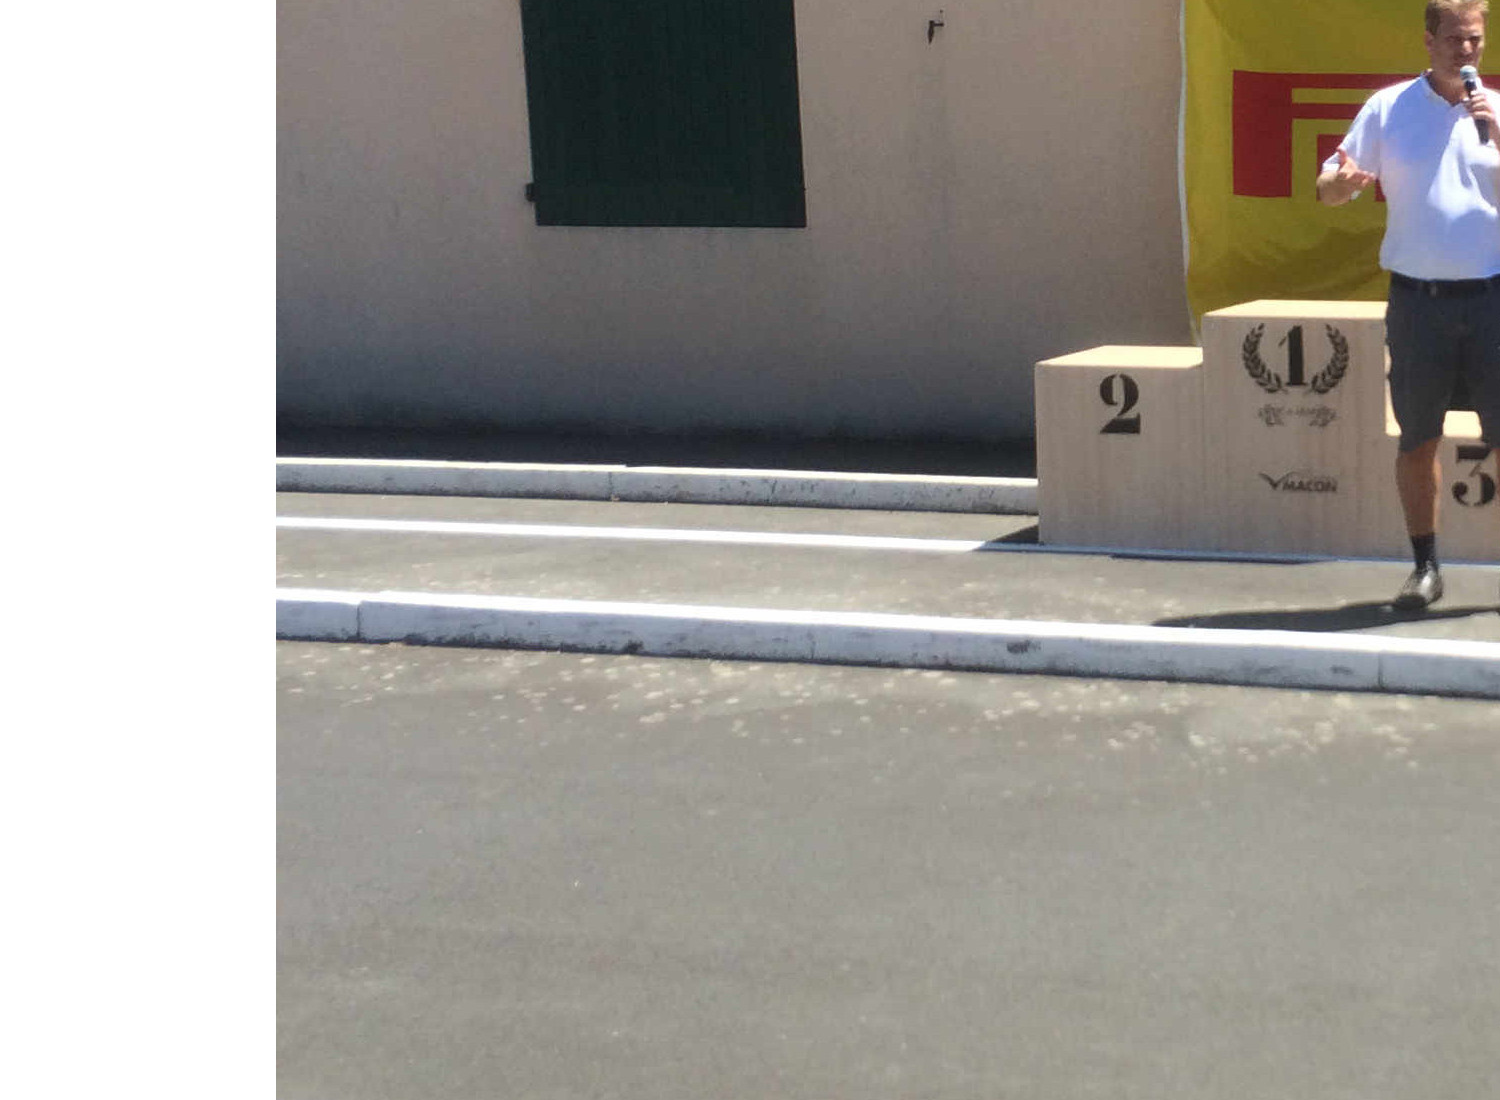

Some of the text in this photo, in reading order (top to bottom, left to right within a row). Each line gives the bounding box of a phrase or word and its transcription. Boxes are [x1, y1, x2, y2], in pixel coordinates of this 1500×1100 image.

[1278, 324, 1307, 388] 1
[1099, 372, 1142, 435] 2
[1451, 444, 1498, 507] 3
